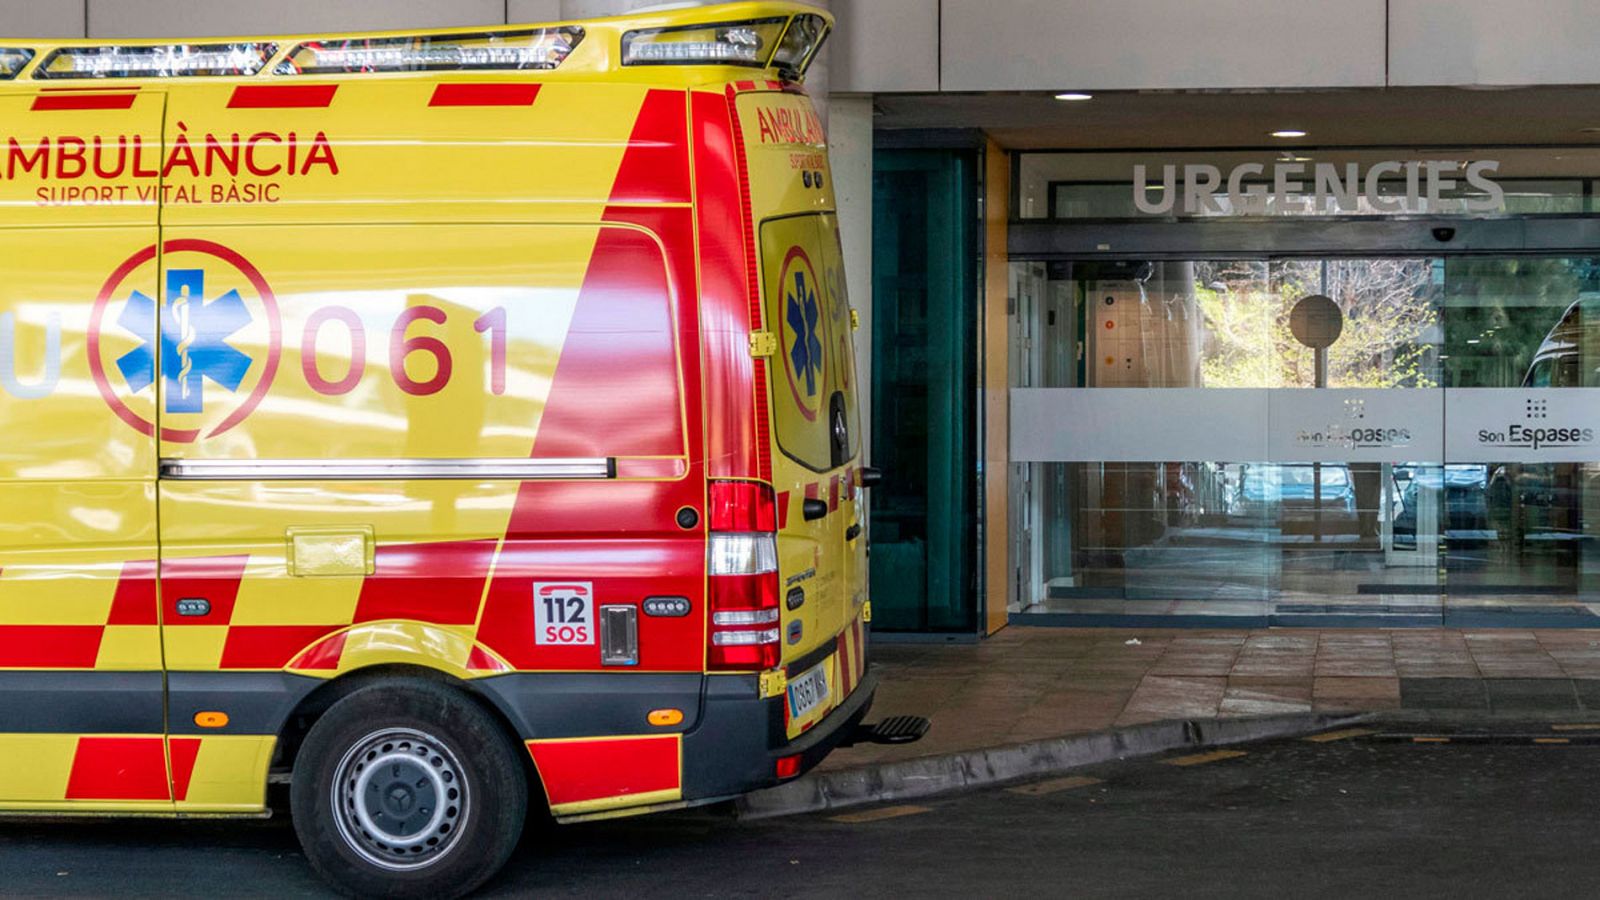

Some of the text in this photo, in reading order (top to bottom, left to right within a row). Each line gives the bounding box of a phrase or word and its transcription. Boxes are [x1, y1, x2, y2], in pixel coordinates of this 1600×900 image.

[0, 121, 338, 180] MBULÀNCIA
[36, 179, 280, 206] SUPORT VITAL BÀSIC
[1133, 152, 1504, 215] URGÈNCIES
[301, 305, 507, 397] 061
[1327, 424, 1411, 449] pases
[1479, 425, 1594, 450] Son Espases
[543, 597, 585, 623] 112
[546, 626, 587, 643] SOS
